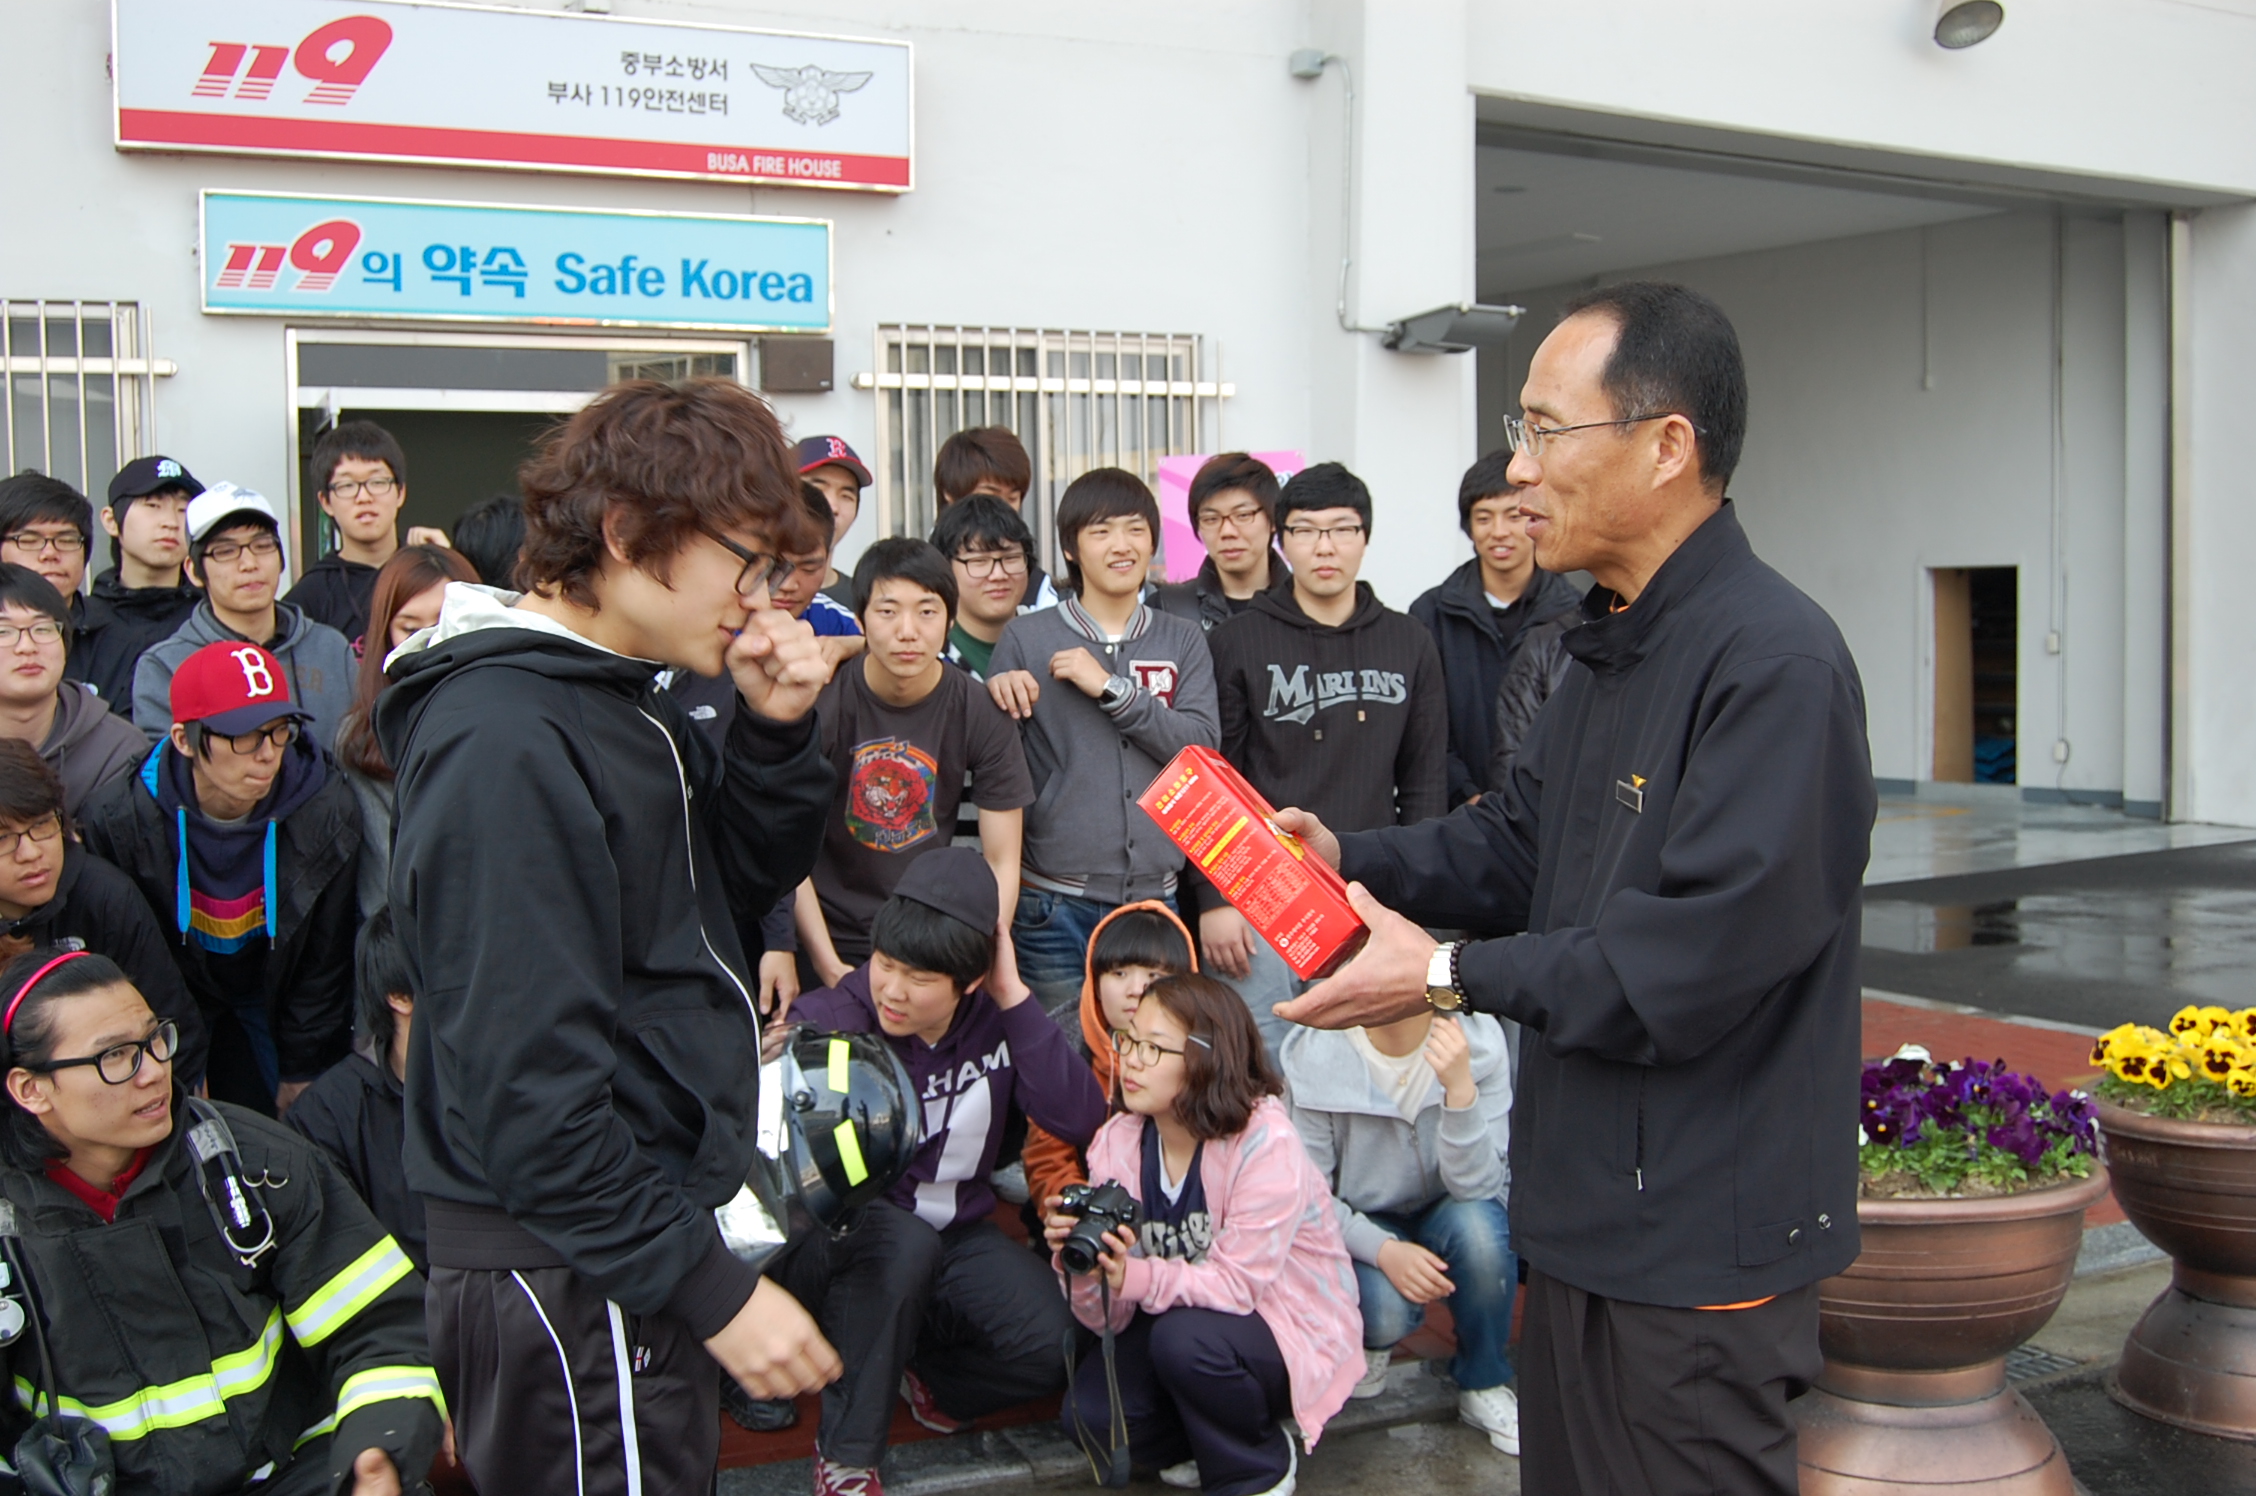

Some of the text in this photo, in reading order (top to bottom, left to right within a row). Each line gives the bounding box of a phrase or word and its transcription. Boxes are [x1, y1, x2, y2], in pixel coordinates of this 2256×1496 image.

[191, 14, 393, 106] 119
[620, 50, 728, 82] 중부소방서
[547, 81, 728, 117] 부사 119안전센터
[707, 152, 842, 179] BUSA FIRE HOUSE
[422, 243, 529, 299] 약속
[554, 251, 666, 298] Safe
[681, 258, 814, 304] Korea
[230, 647, 273, 698] B
[921, 1040, 1011, 1100] HAM
